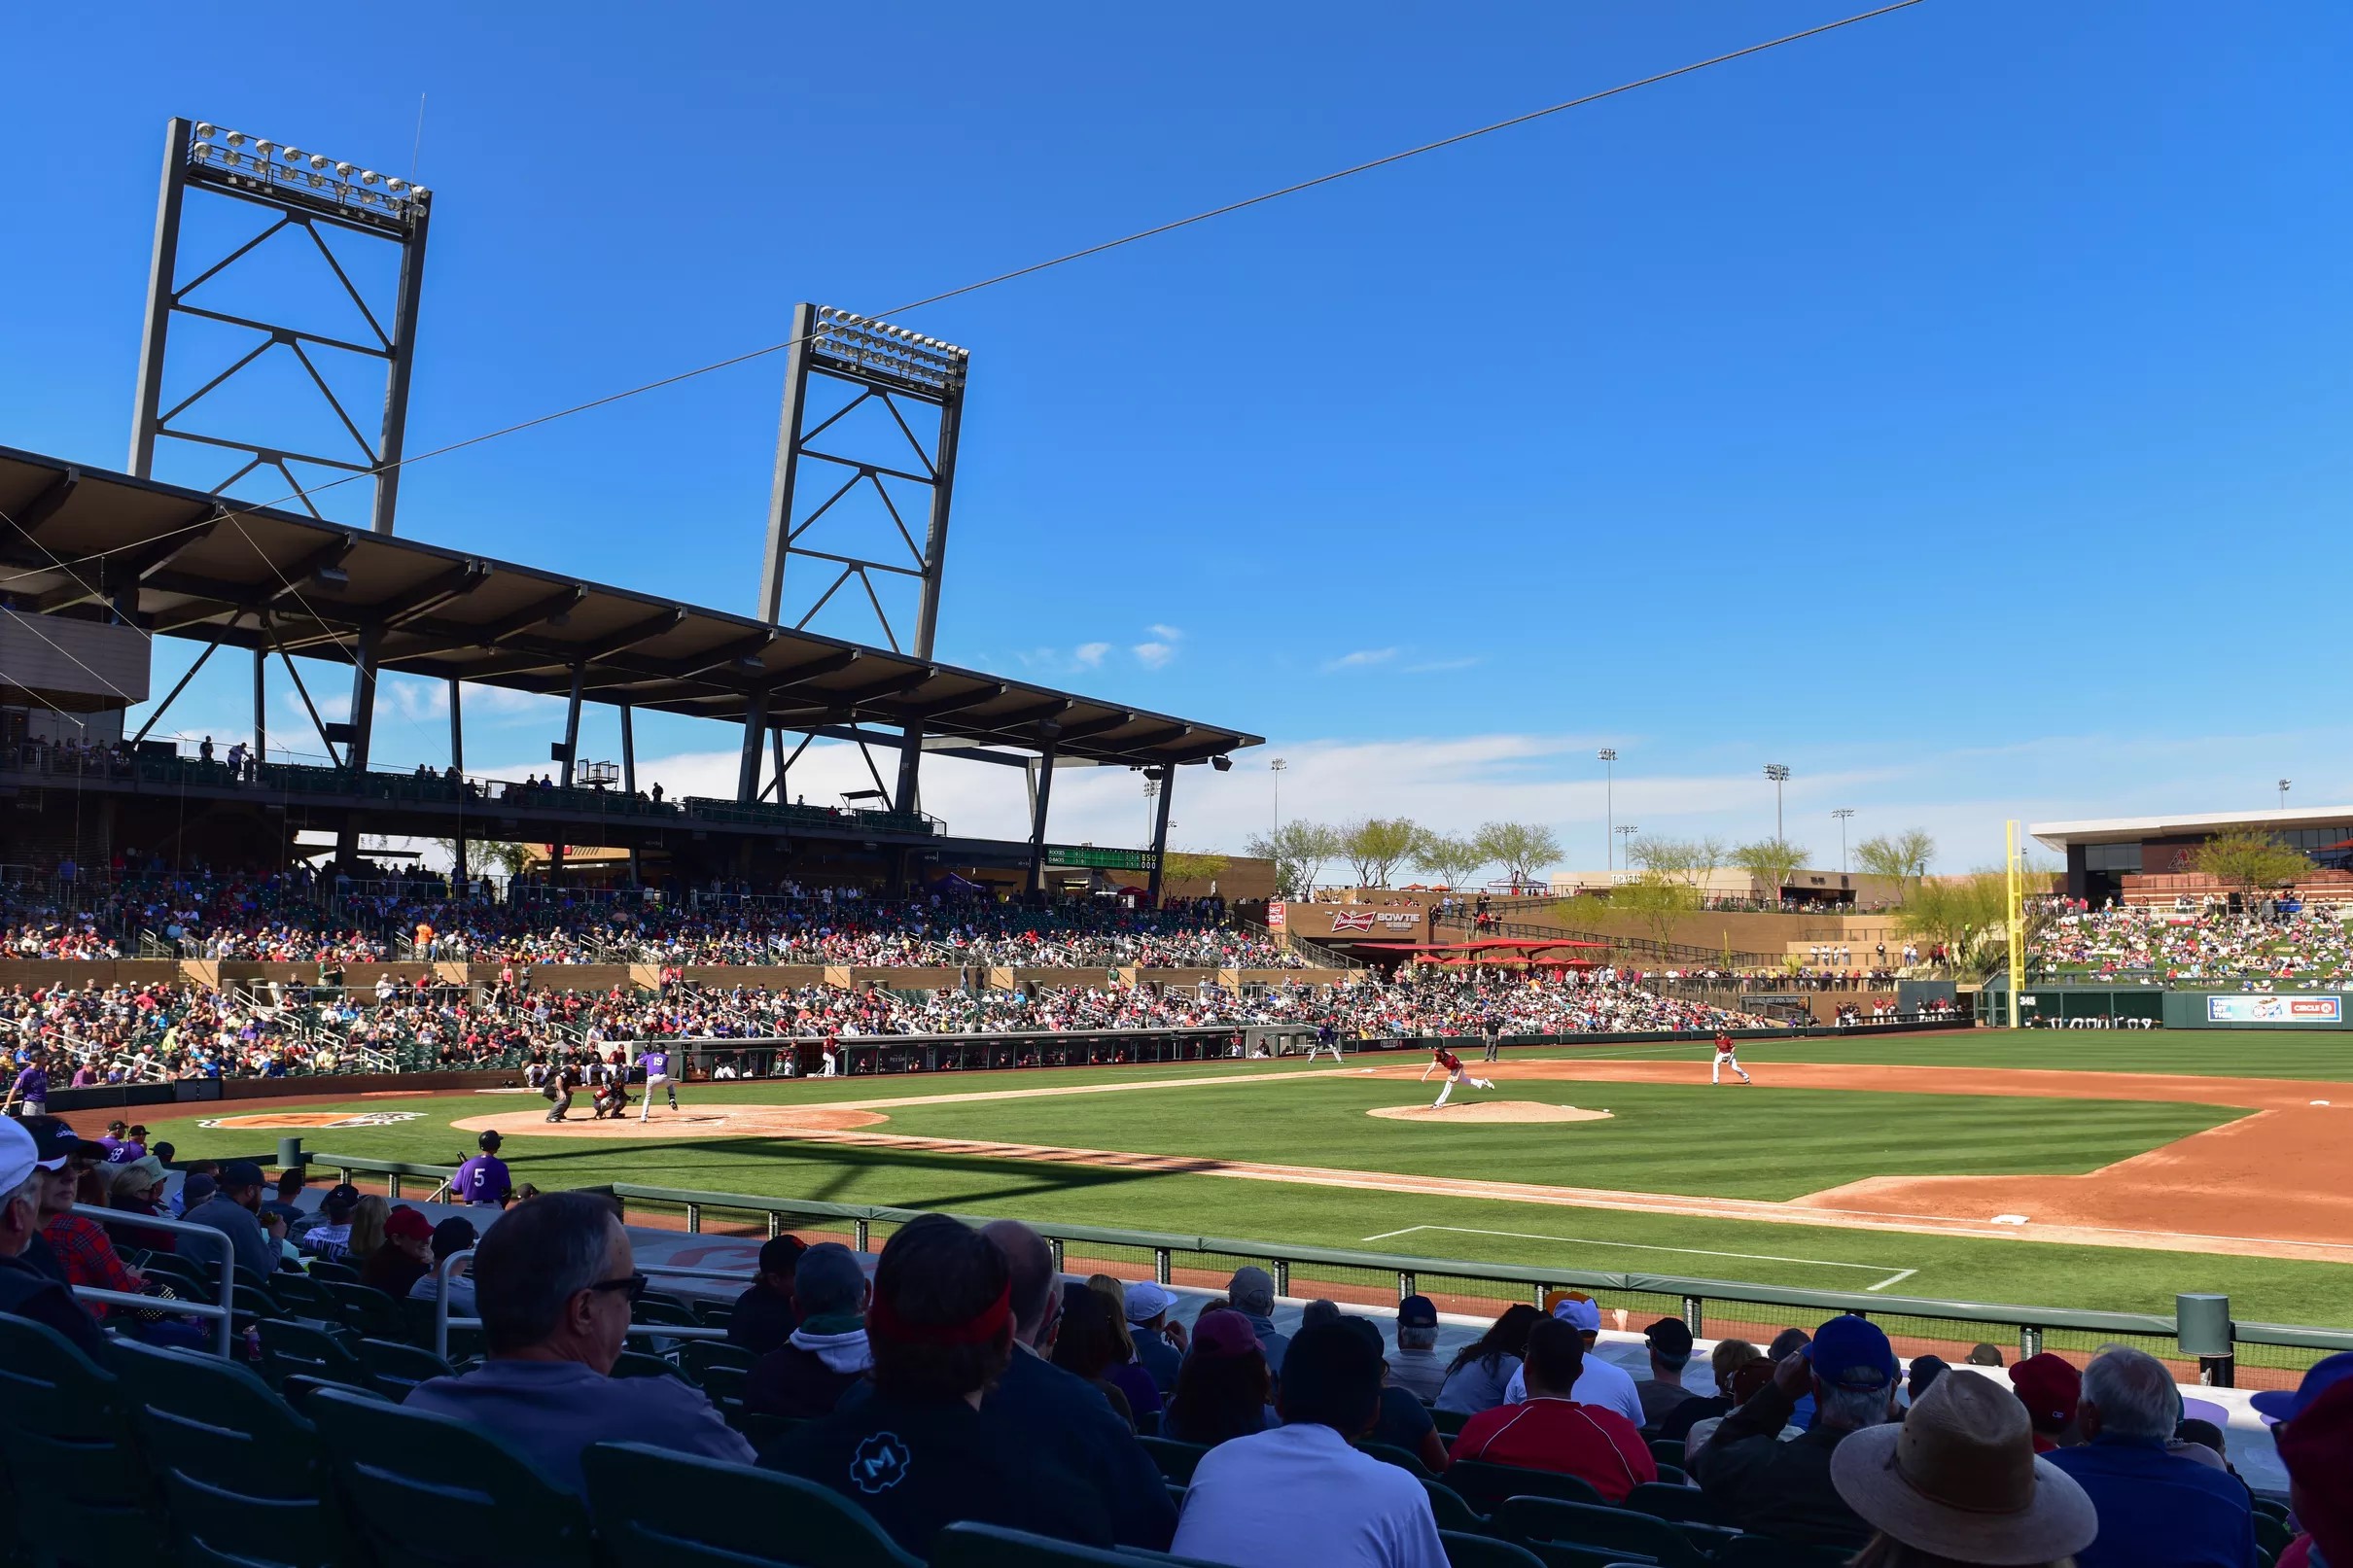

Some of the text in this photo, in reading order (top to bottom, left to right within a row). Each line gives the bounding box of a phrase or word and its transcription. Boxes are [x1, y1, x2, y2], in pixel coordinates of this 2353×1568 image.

[1611, 874, 1641, 885] TICKETS
[1377, 913, 1420, 922] BOWTIE
[2019, 996, 2036, 1006] 345
[653, 1056, 663, 1066] 19
[474, 1168, 485, 1187] 5
